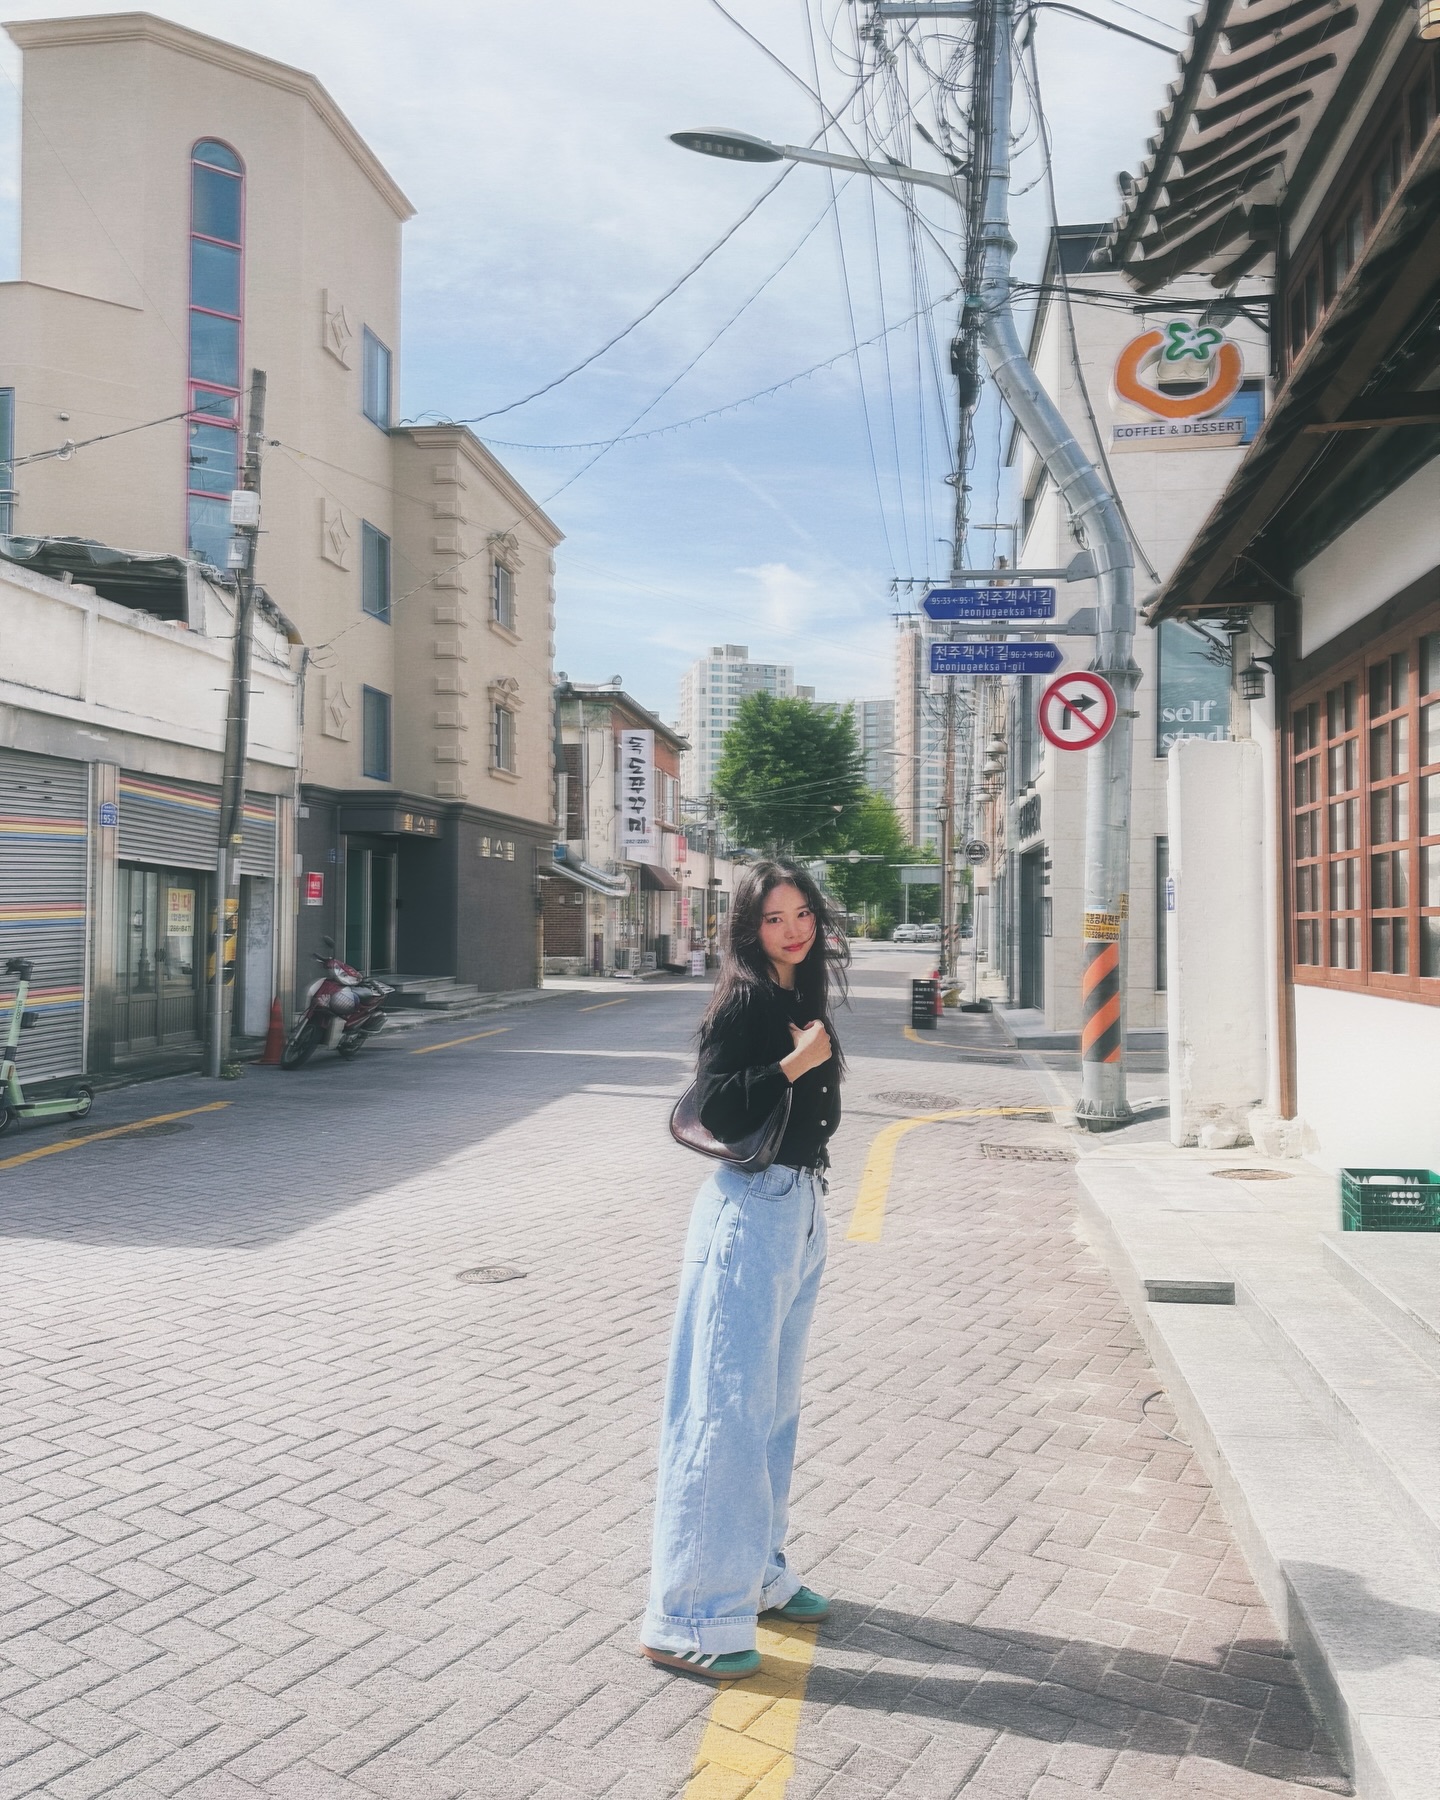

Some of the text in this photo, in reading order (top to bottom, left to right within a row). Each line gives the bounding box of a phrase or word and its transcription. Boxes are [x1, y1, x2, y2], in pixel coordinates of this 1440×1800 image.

[1116, 421, 1243, 438] COFFEE & DESSERT
[959, 597, 974, 605] 95-1
[977, 589, 1052, 606] 전주객사1길
[959, 606, 1052, 619] Jeonjugaeksa 1-gil
[935, 645, 1055, 661] 전주객사1길 96-2 96-40
[934, 661, 1026, 673] Jeonjugaeksa 1-gil
[1162, 699, 1218, 723] self
[171, 892, 192, 912] 임대
